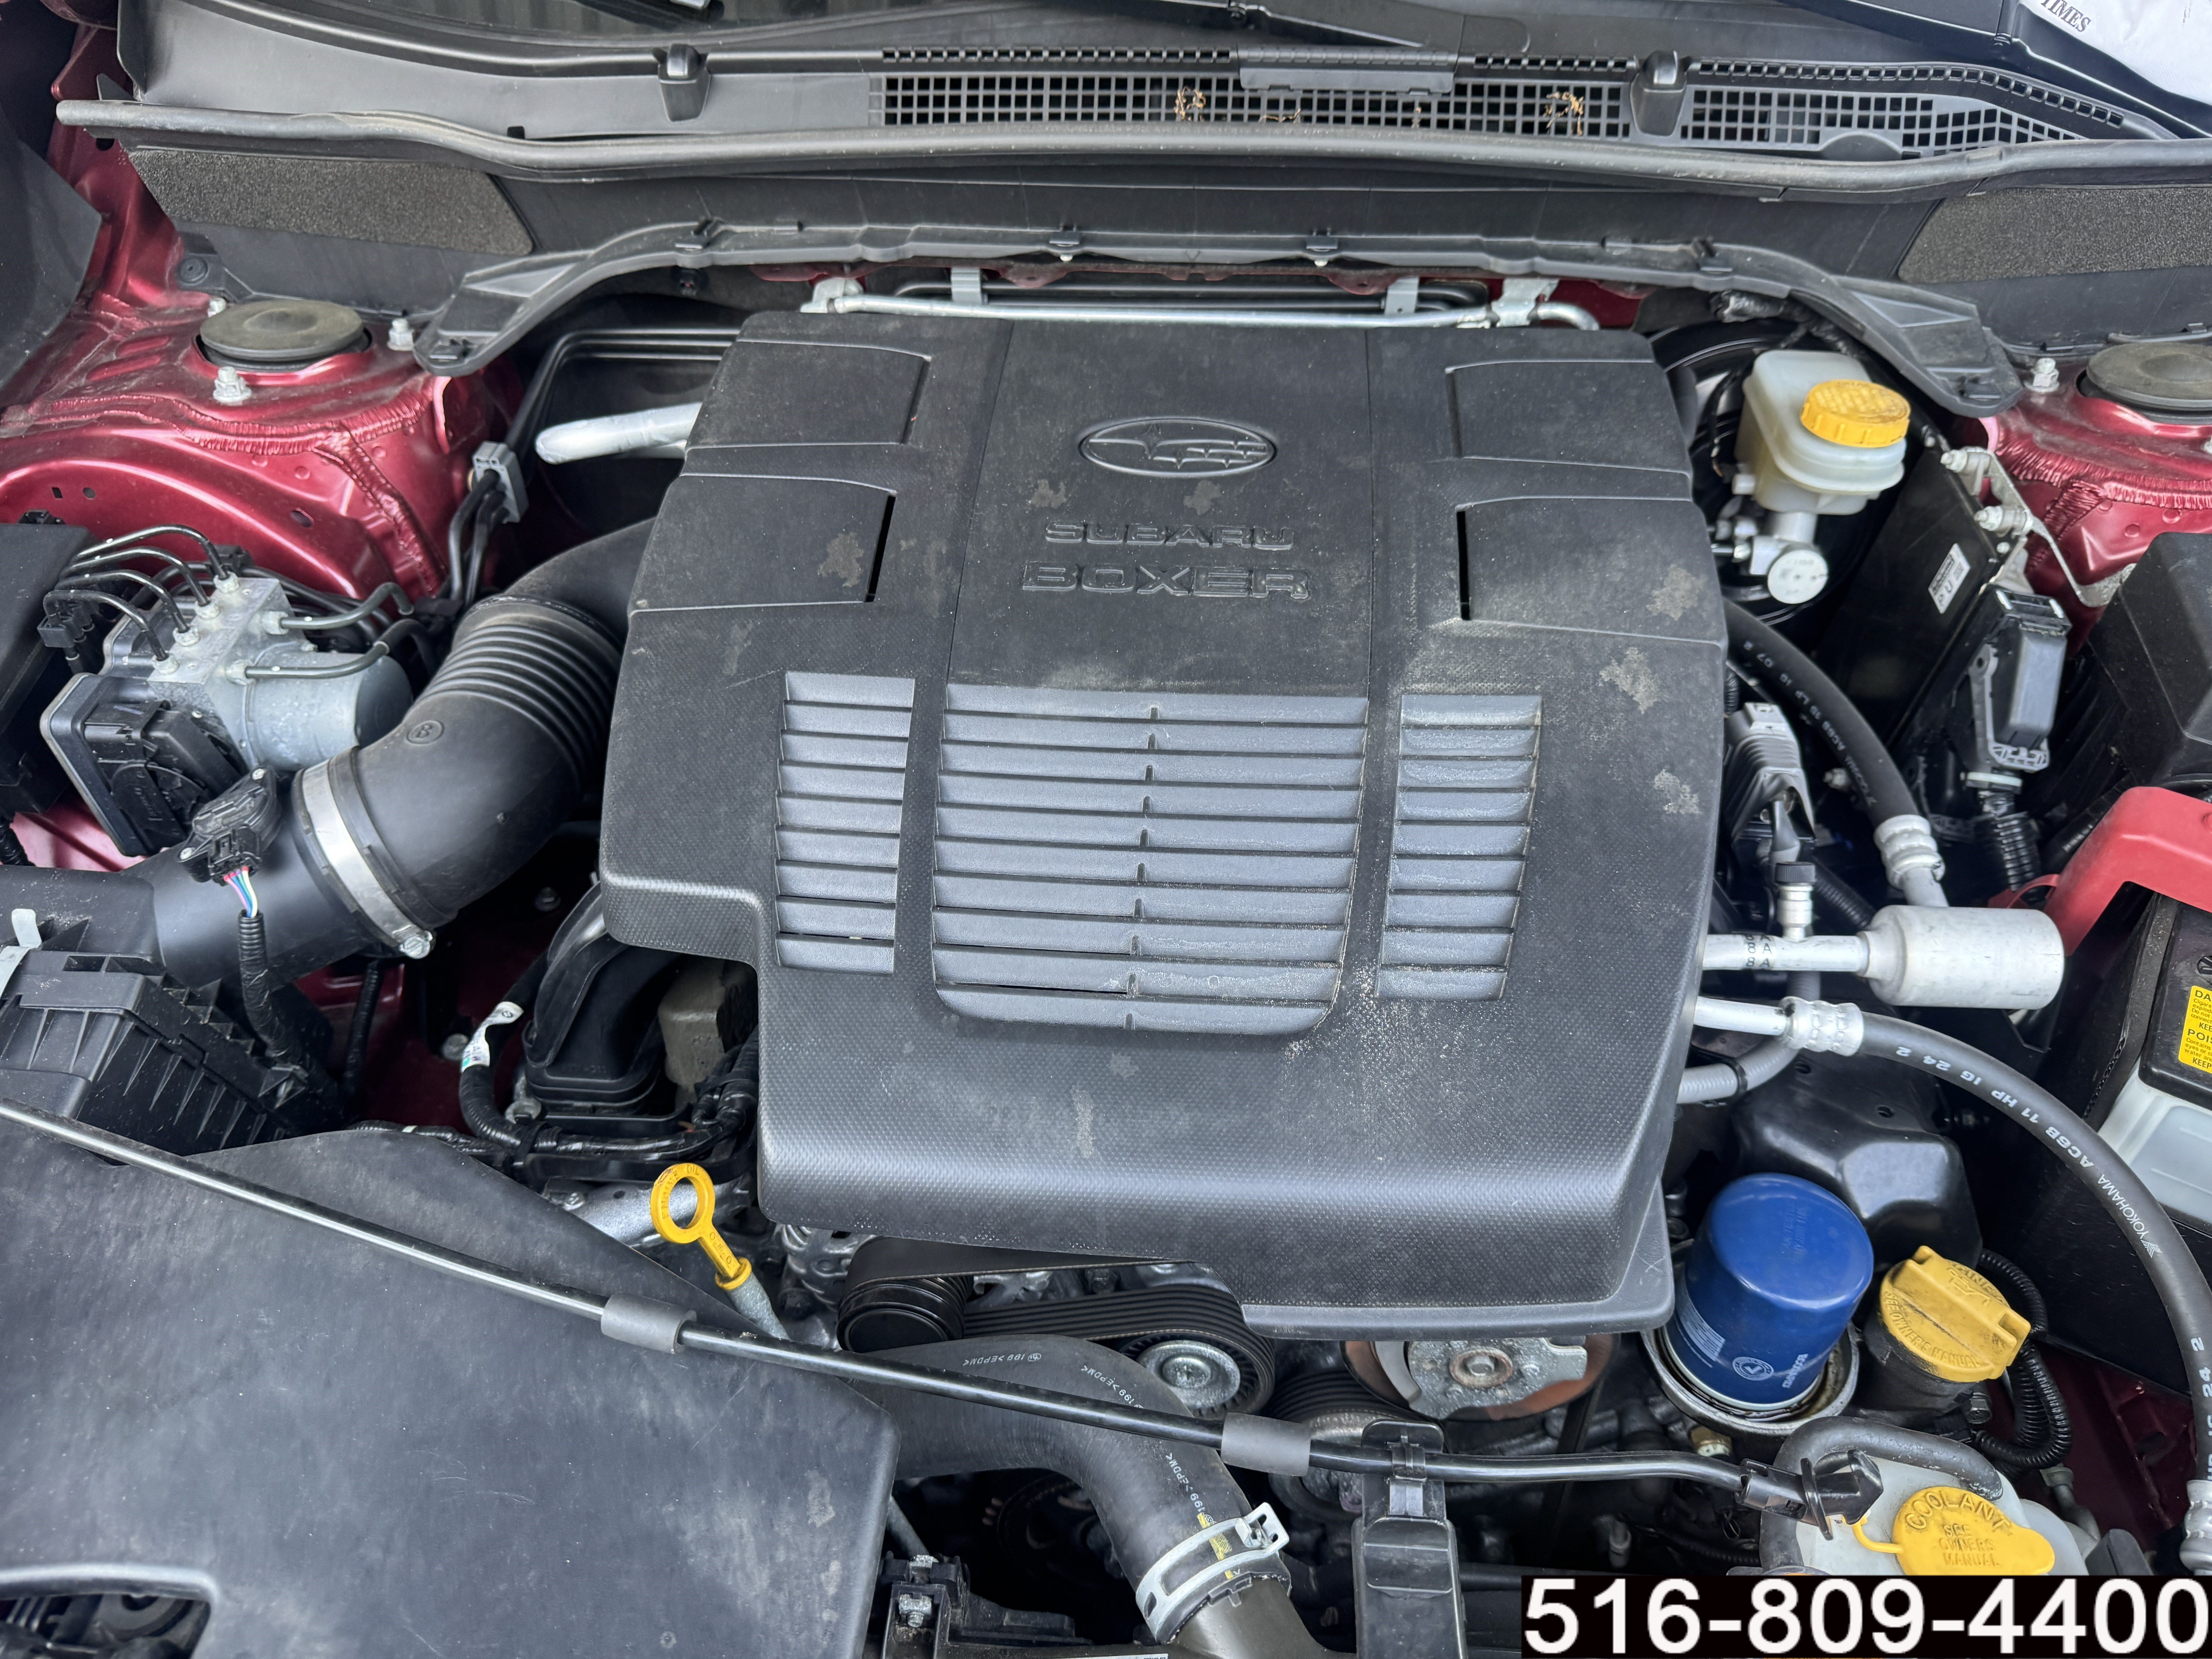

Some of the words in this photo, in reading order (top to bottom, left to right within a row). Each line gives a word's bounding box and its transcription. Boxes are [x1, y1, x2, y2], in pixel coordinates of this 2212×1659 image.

[1045, 524, 1294, 551] SUBARU
[1021, 560, 1309, 599] BOXER
[1896, 1046, 1912, 1057] 2
[1923, 1055, 1951, 1071] 24
[2193, 1057, 2212, 1068] KEEP
[1991, 1090, 2018, 1108] HP
[2021, 1108, 2039, 1123] 11
[687, 1164, 699, 1176] OIL
[2097, 1174, 2149, 1239] YOKOHAMA
[1884, 1291, 1903, 1311] SEE
[1932, 1346, 1980, 1368] MANUAL
[2190, 1337, 2205, 1352] 2
[1905, 1491, 2011, 1530] COOLANT
[1942, 1524, 1973, 1537] SEE
[1942, 1552, 2001, 1566] MANUAL
